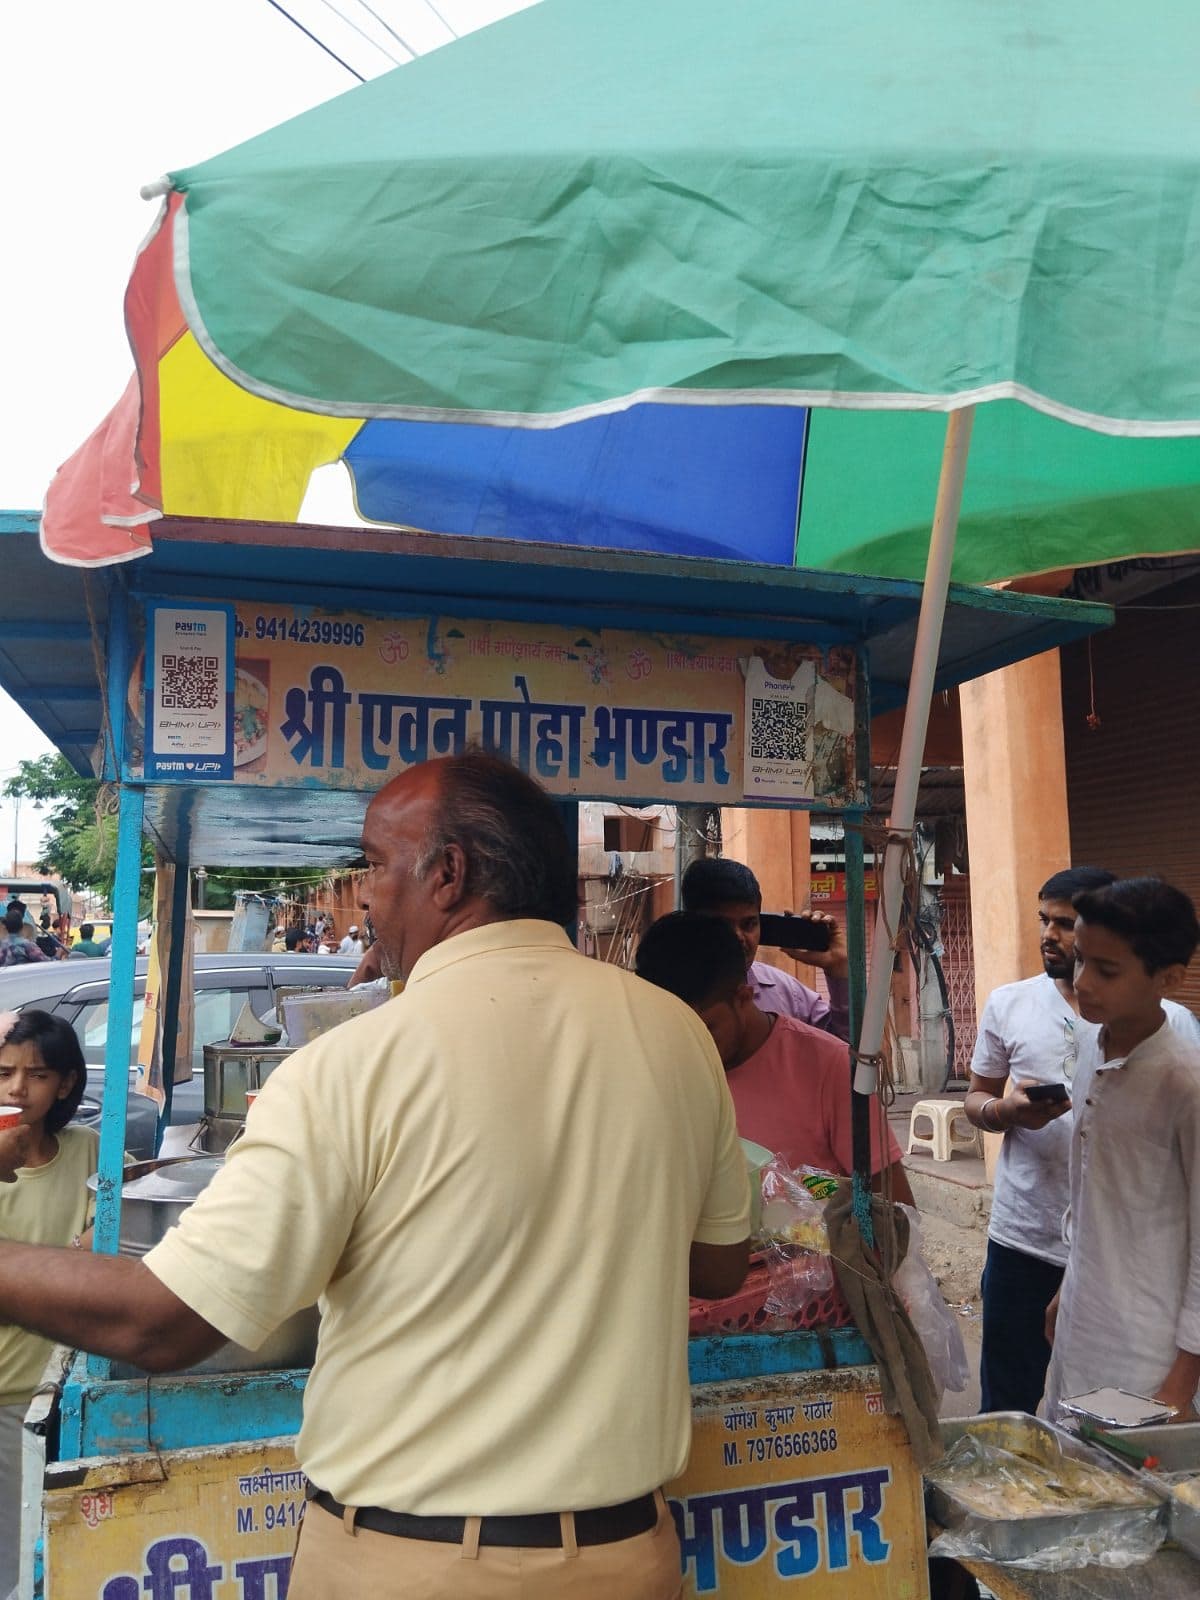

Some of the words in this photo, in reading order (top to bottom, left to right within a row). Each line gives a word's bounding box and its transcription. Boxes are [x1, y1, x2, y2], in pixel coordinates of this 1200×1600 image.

[255, 616, 365, 646] 9414239996
[280, 665, 352, 768] श्री
[479, 675, 587, 779] पोहा
[593, 706, 733, 785] भण्डार
[865, 1392, 884, 1415] ला
[723, 1407, 758, 1431] योगेश
[765, 1406, 796, 1432] कुमार
[724, 1442, 742, 1466] M.
[746, 1429, 838, 1462] 7976566368
[237, 1507, 259, 1532] M.
